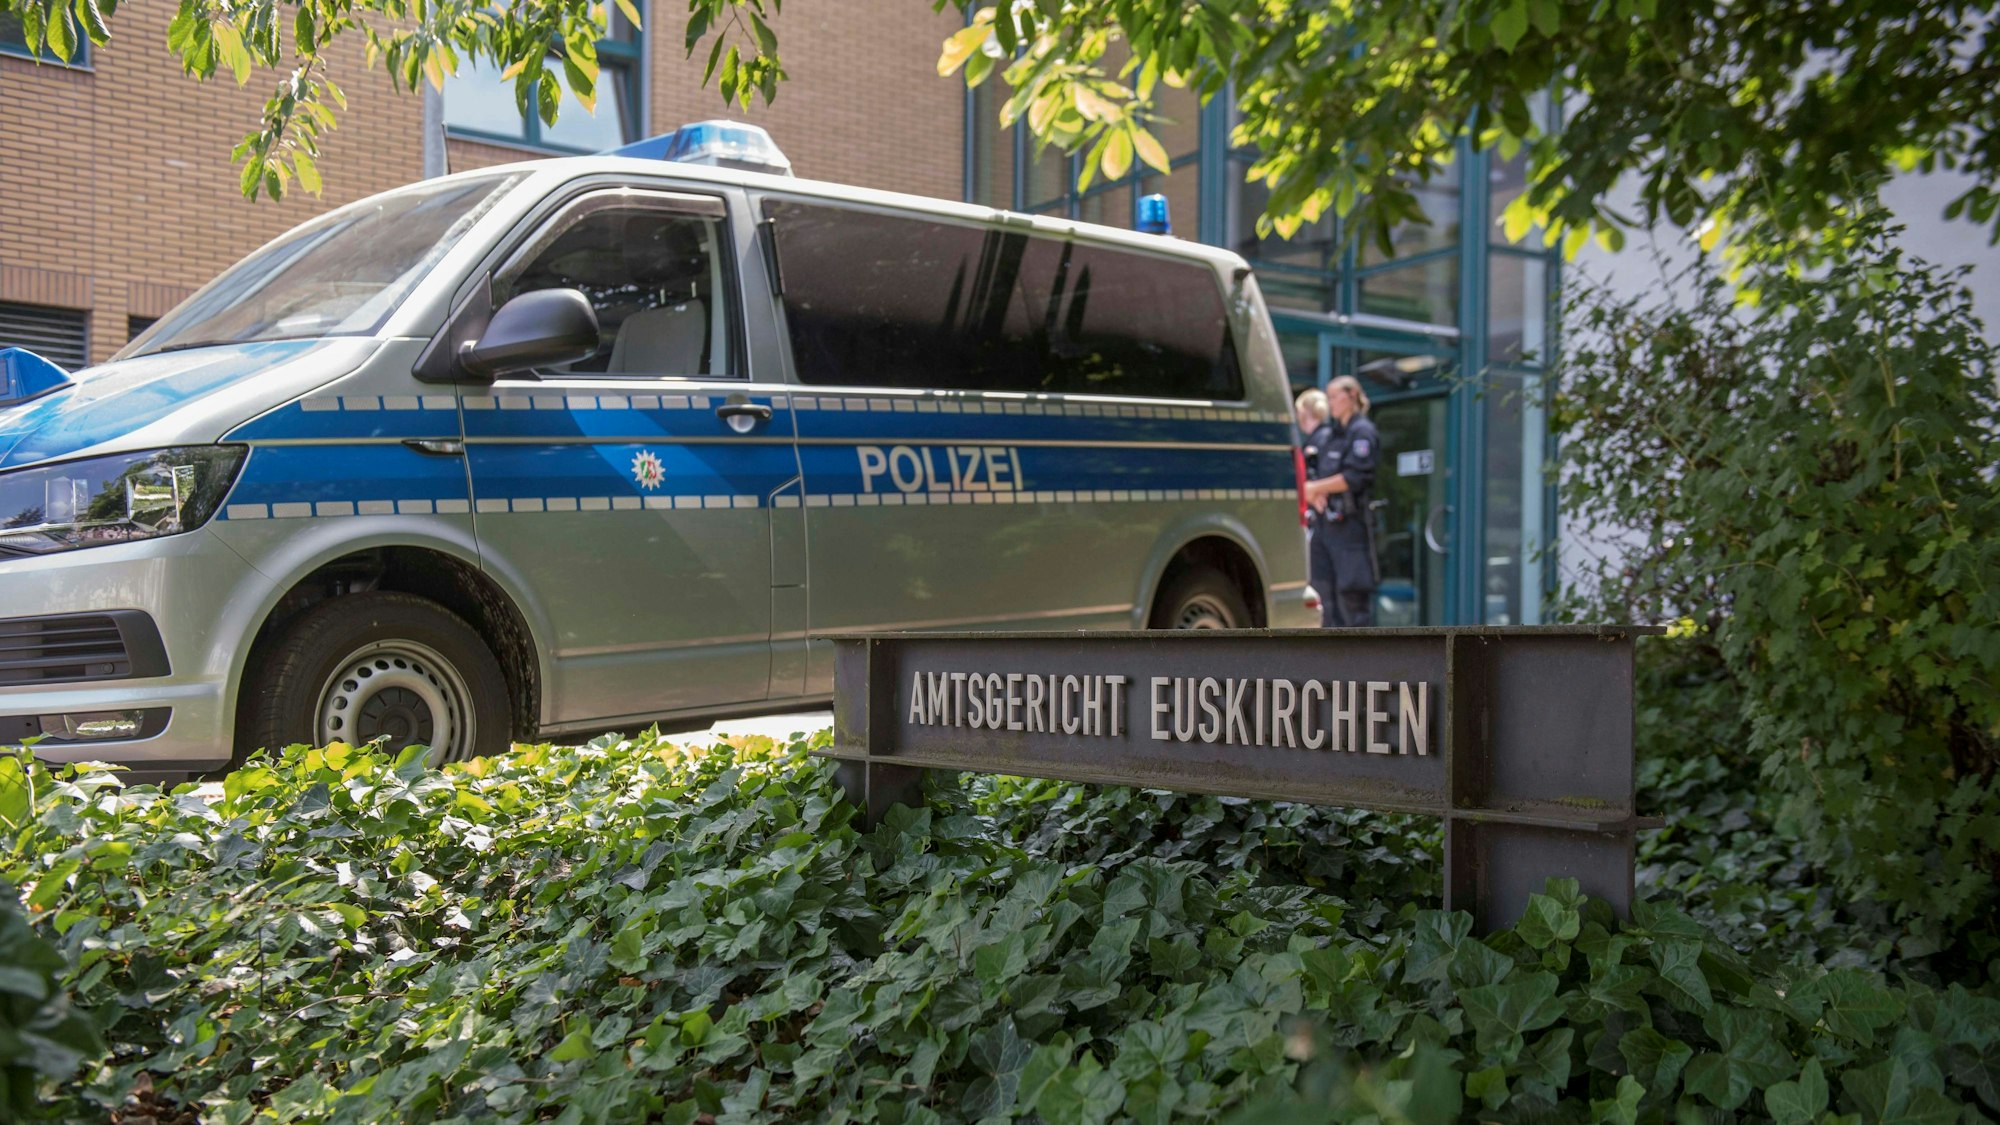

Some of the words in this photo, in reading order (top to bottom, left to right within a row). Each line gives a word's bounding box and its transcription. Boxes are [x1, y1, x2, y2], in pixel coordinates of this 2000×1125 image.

[856, 446, 1023, 493] POLIZEI
[908, 671, 1127, 737] AMTSGERICHT
[1150, 676, 1429, 756] EUSKIRCHEN
